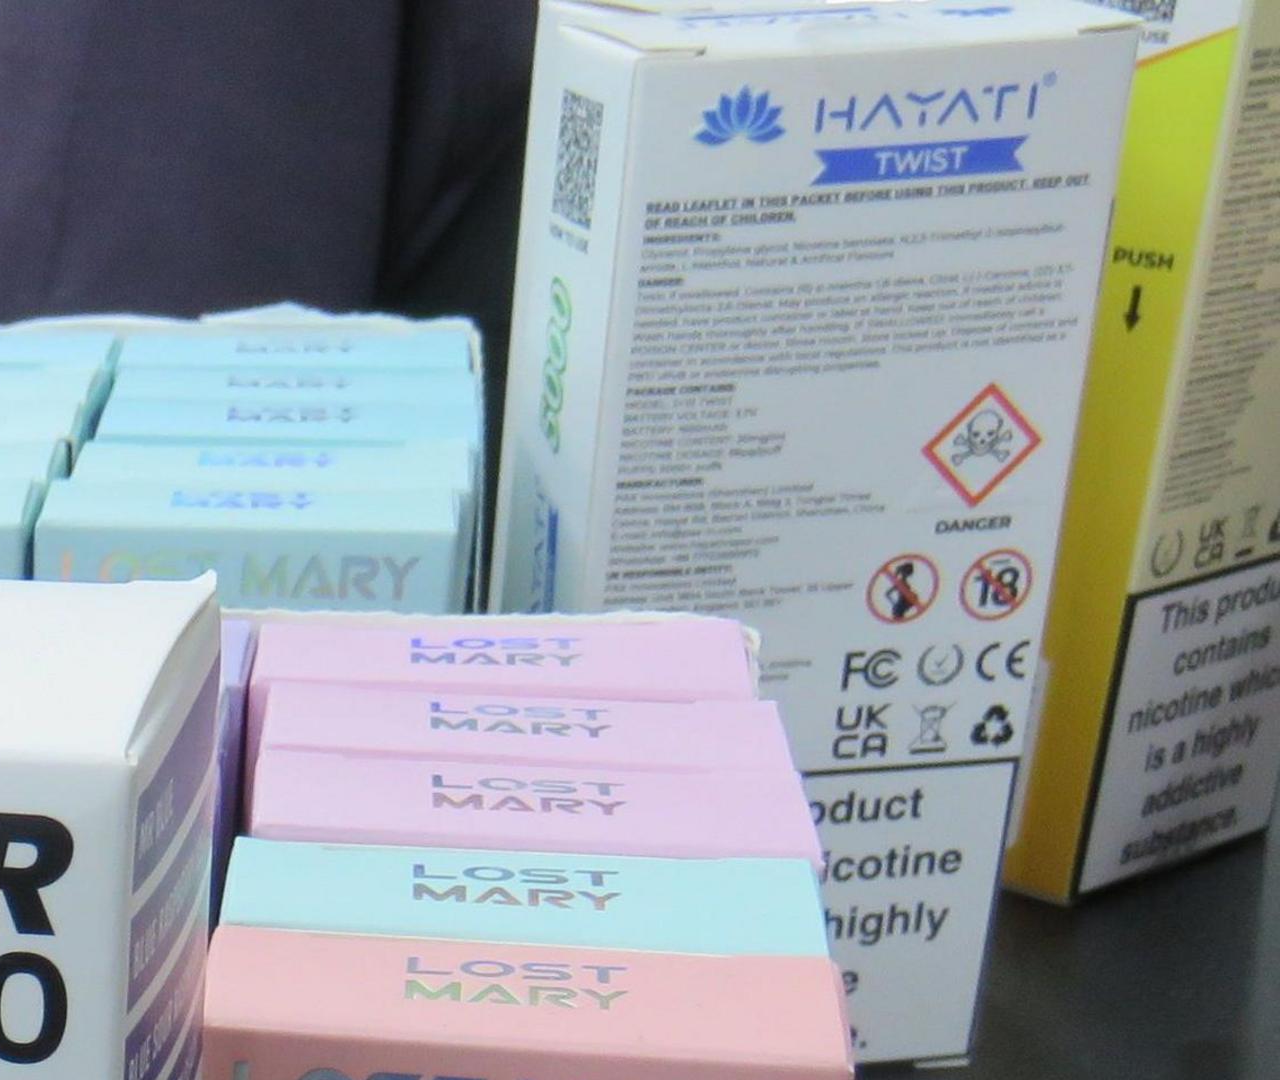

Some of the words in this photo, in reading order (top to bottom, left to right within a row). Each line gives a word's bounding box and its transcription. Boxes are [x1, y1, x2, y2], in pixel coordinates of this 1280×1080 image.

[814, 82, 1040, 133] HAYATI
[875, 145, 970, 177] TWIST
[646, 201, 680, 214] READ
[758, 195, 789, 209] THIS
[791, 191, 841, 206] PACKET
[894, 185, 933, 200] USING
[937, 183, 965, 197] THIS
[664, 214, 708, 229] REACH
[1113, 246, 1175, 270] PUSH
[935, 515, 1012, 535] DANGER
[243, 553, 421, 600] MARY
[1161, 598, 1211, 634] This
[409, 637, 583, 651] LOST
[1173, 626, 1273, 677] contains
[409, 652, 585, 668] MARY
[429, 701, 610, 721] LOST
[1127, 685, 1224, 735] nicotine
[1228, 666, 1280, 702] whic
[429, 716, 613, 738] MARY
[836, 703, 891, 732] UK
[832, 733, 889, 760] CA
[1144, 740, 1165, 773] is
[1171, 738, 1188, 766] a
[1191, 713, 1262, 760] highly
[430, 774, 626, 796] LOST
[1141, 763, 1244, 819] addictive
[431, 792, 628, 815] MARY
[810, 788, 925, 825] oduct
[411, 863, 620, 887] LOST
[821, 844, 963, 884] icotine
[411, 883, 623, 911] MARY
[405, 956, 629, 984] LOST
[404, 979, 630, 1010] MARY
